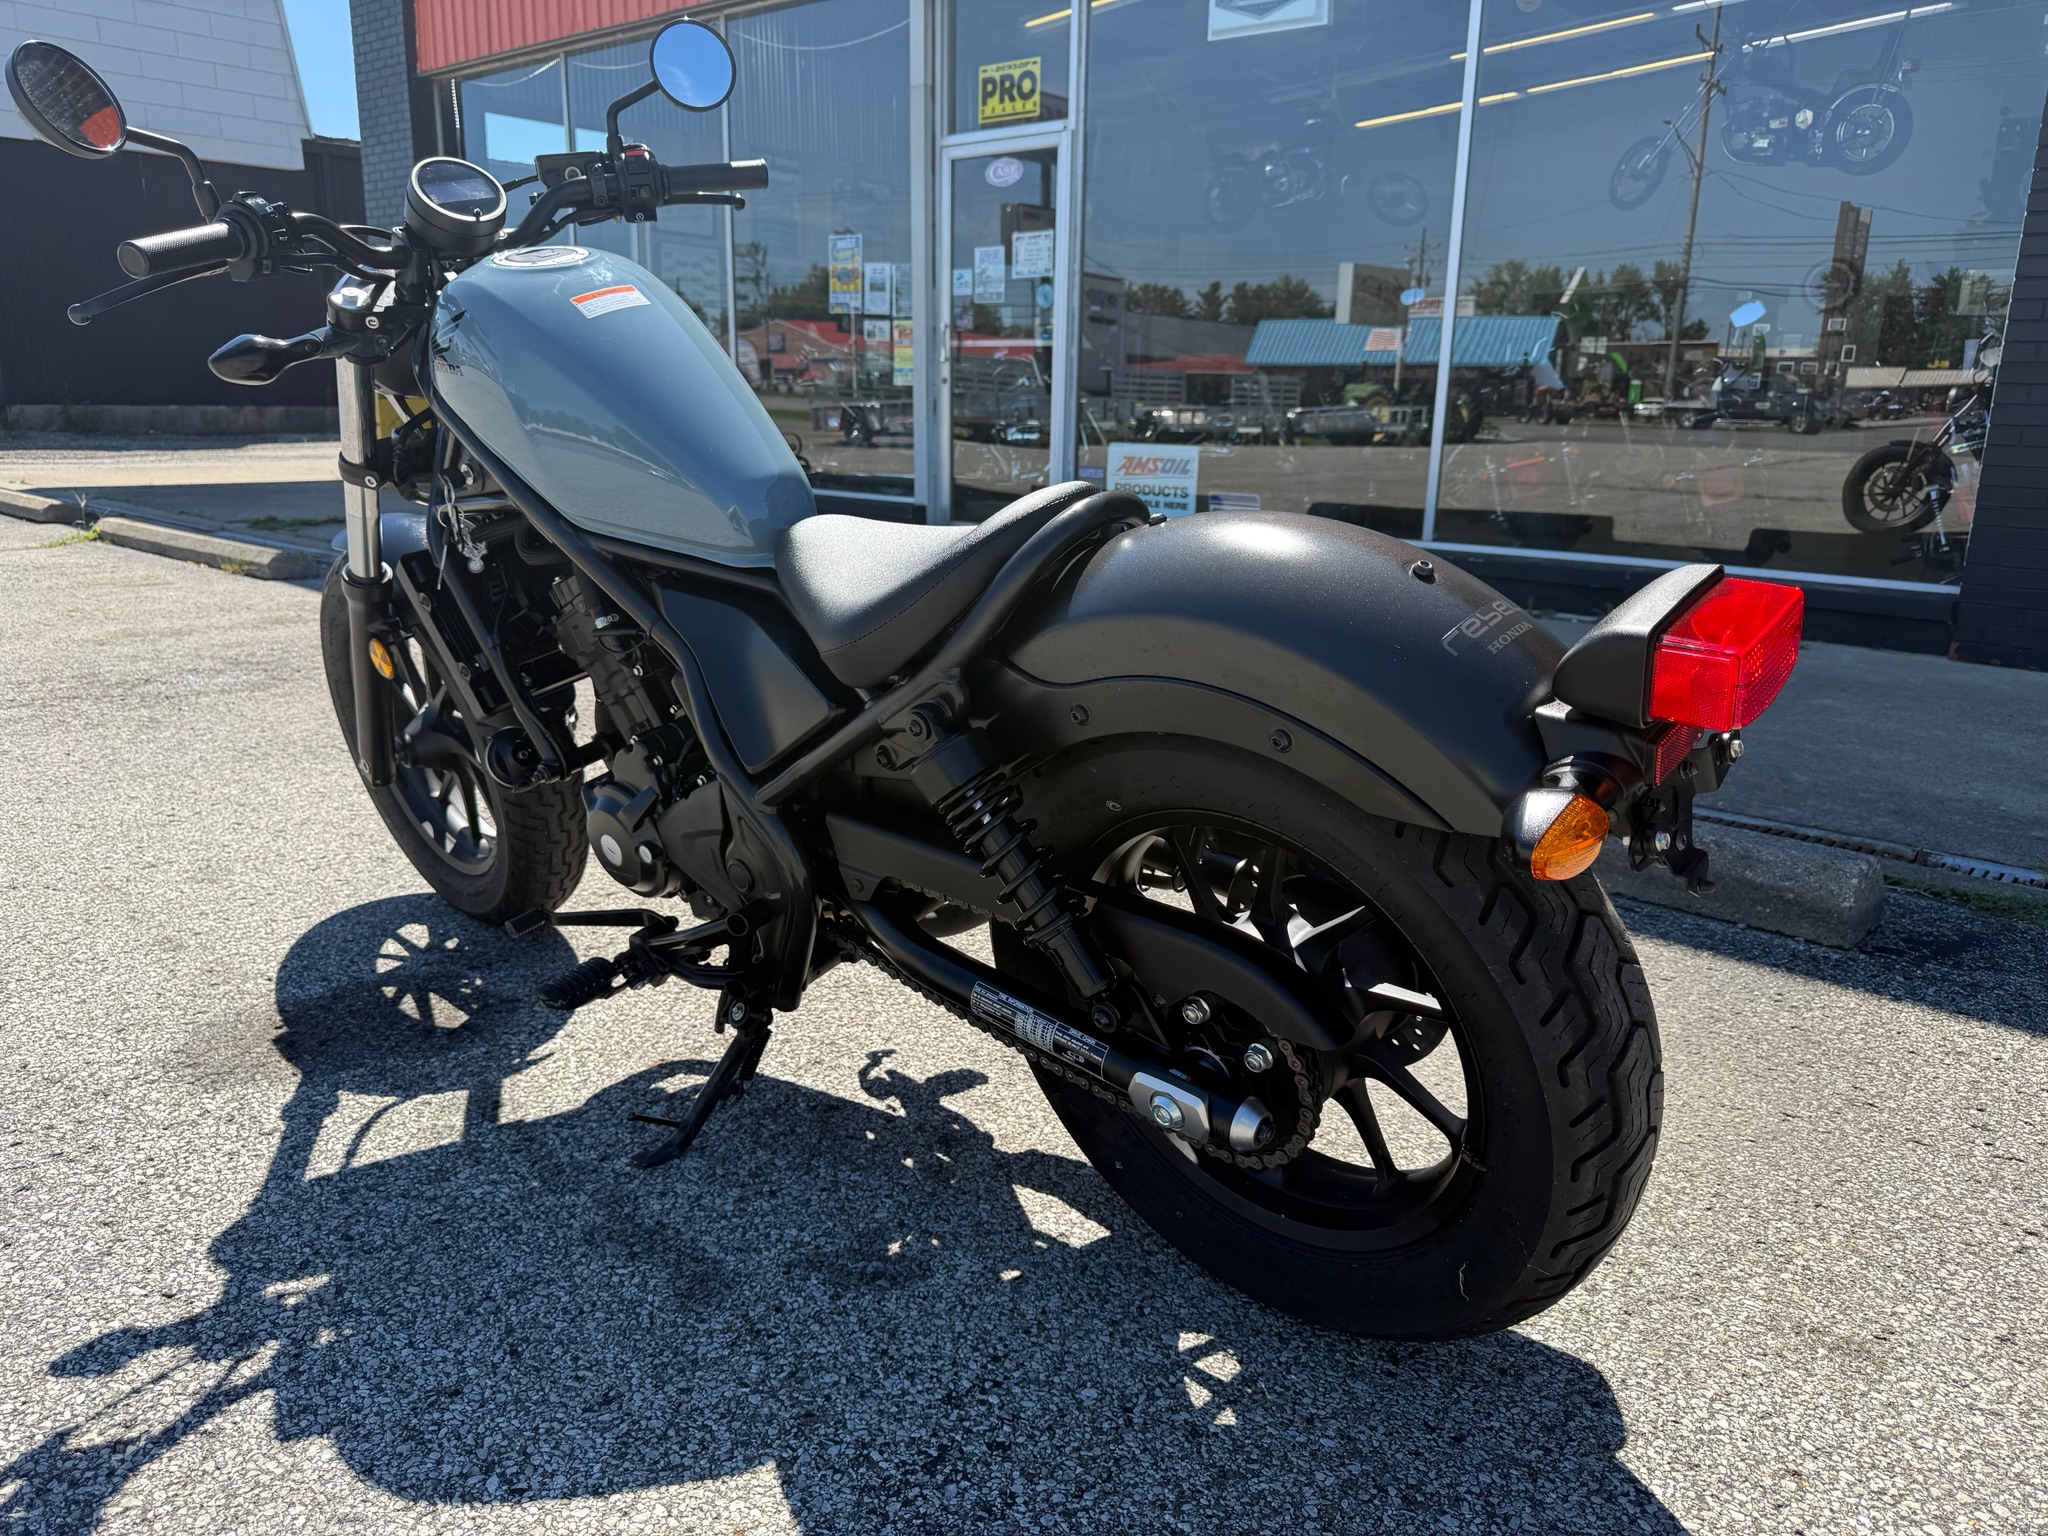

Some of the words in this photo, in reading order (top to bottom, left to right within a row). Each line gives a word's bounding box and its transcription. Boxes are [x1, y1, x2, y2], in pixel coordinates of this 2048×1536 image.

[981, 69, 1038, 107] PRO
[981, 101, 1037, 116] DEALER
[1116, 455, 1191, 476] AMSOIL
[1114, 482, 1189, 499] PRODUCTS
[1486, 621, 1533, 655] HONDA
